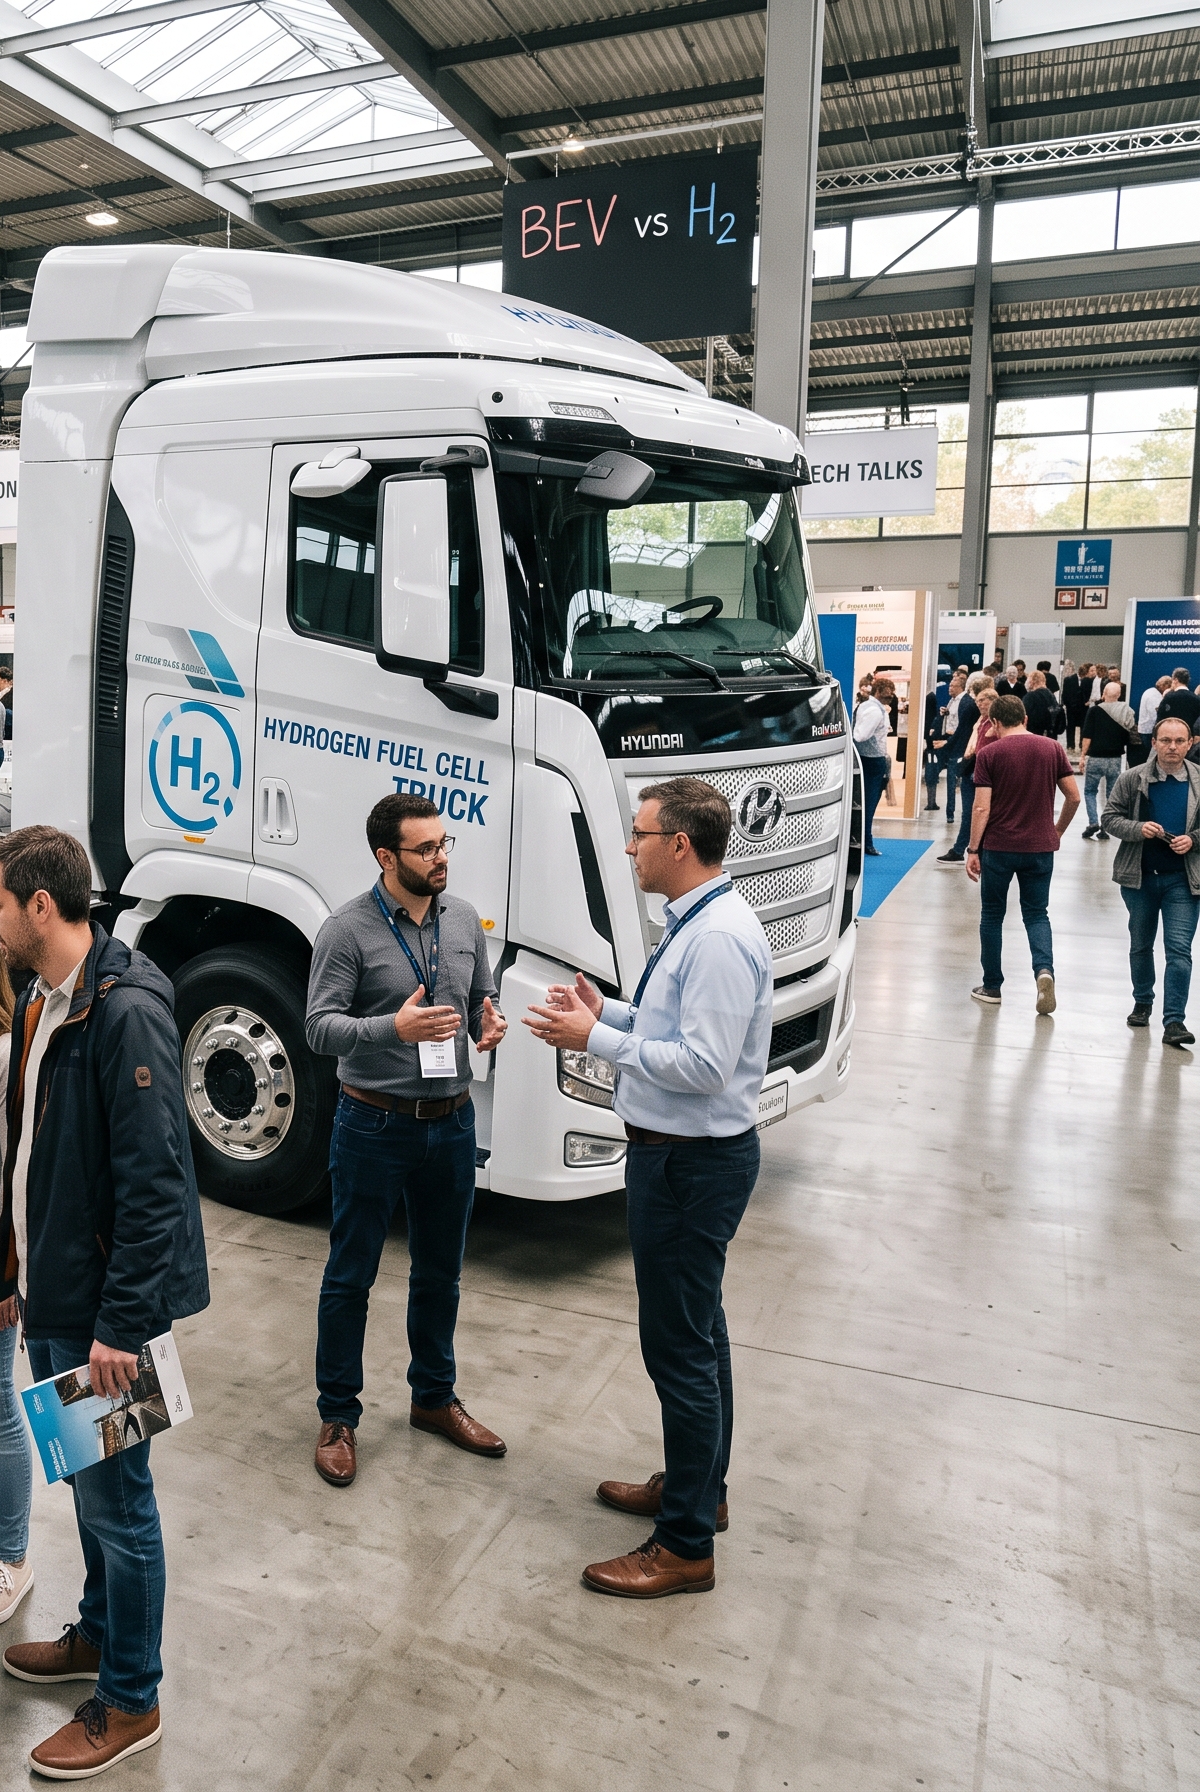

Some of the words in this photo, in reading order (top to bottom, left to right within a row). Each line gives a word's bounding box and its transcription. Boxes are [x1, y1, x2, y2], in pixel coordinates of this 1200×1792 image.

[522, 194, 618, 259] BEV
[634, 213, 669, 238] vs
[689, 182, 737, 245] H2
[811, 463, 850, 483] ECH
[857, 459, 923, 481] TALKS
[170, 734, 221, 806] H2
[263, 717, 371, 760] HYDROGEN
[376, 739, 428, 773] FUEL
[435, 752, 490, 785] CELL
[621, 733, 684, 751] HYUNDAI
